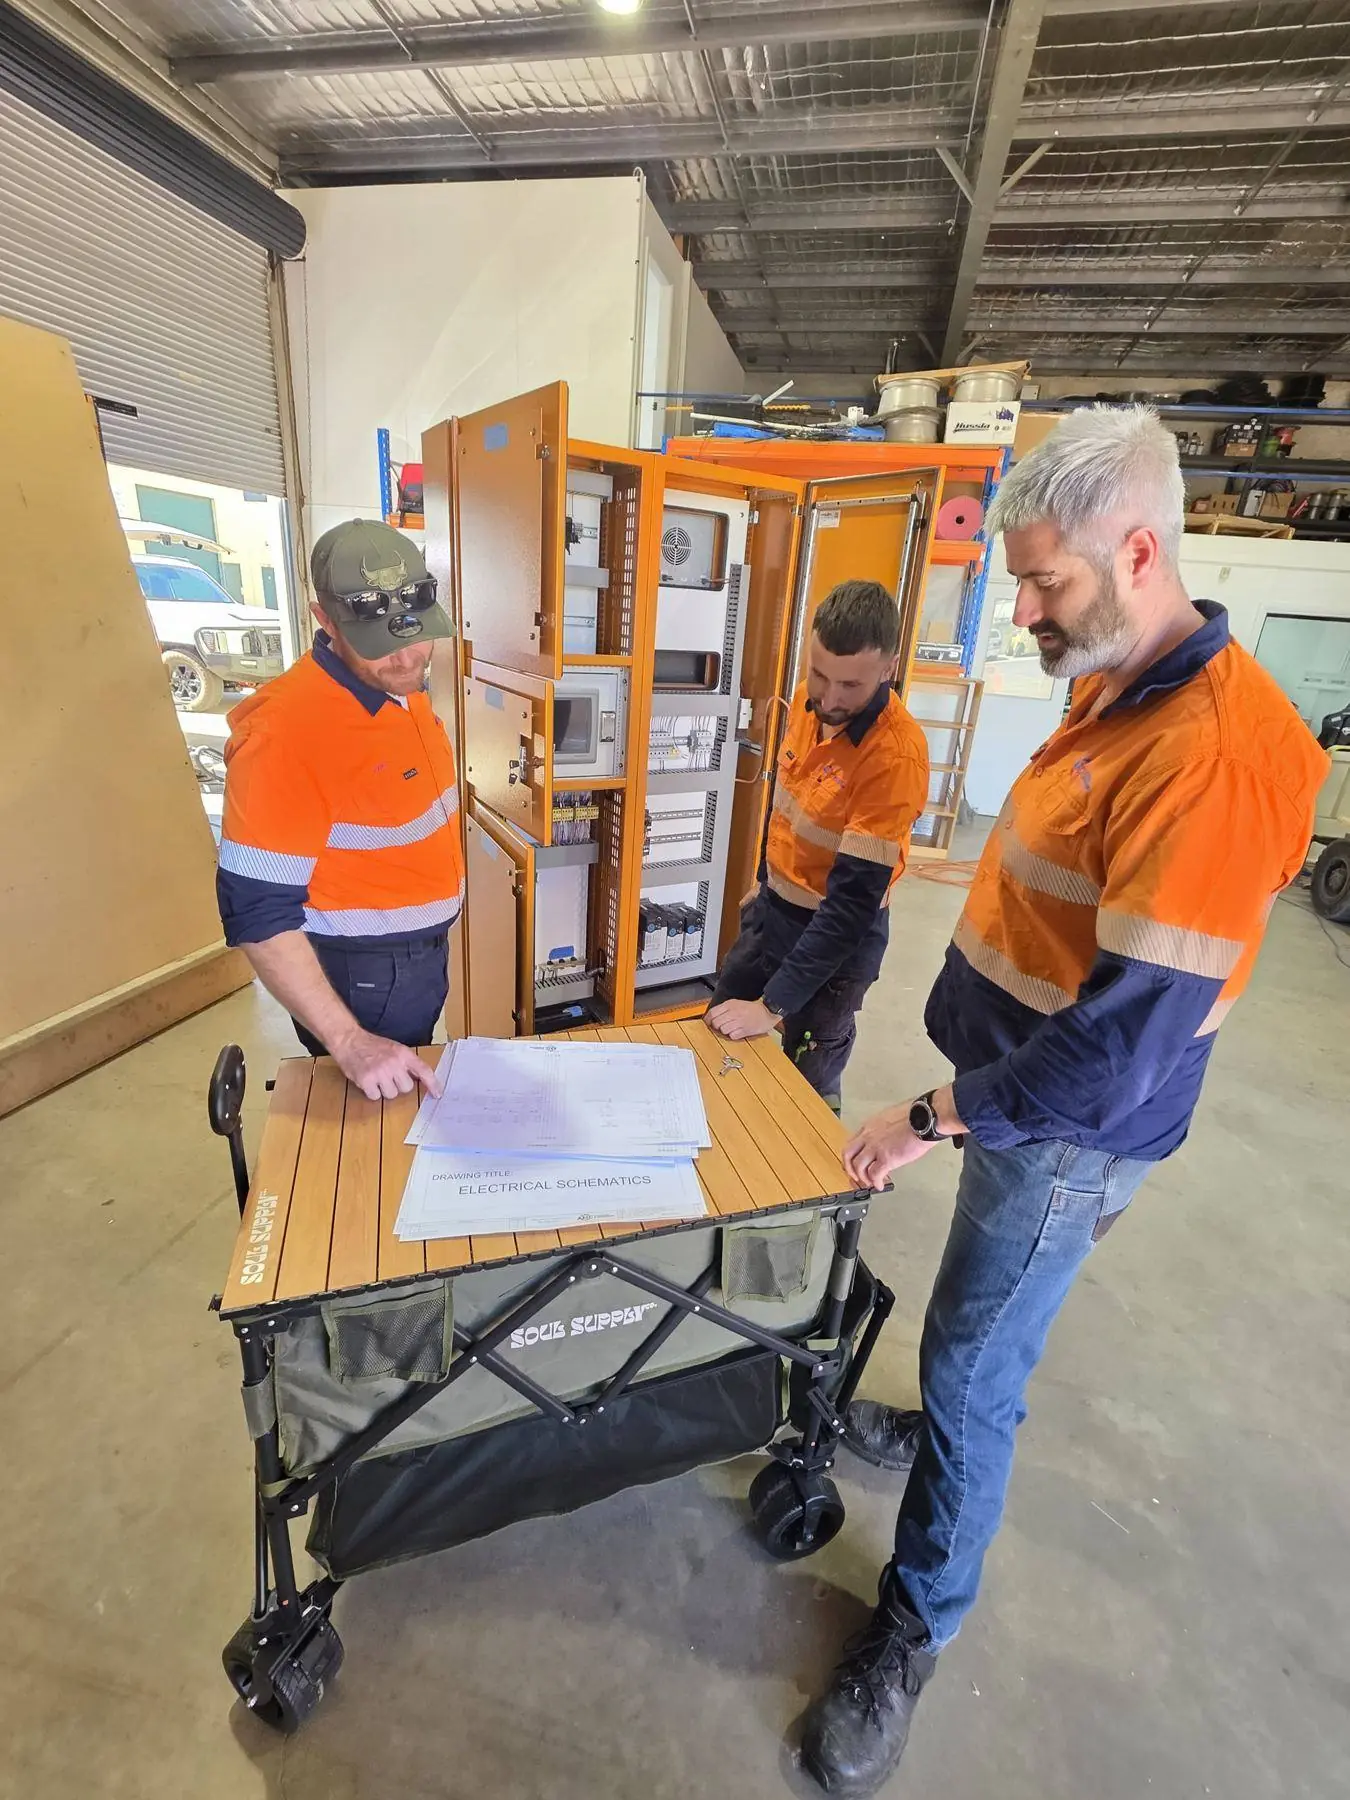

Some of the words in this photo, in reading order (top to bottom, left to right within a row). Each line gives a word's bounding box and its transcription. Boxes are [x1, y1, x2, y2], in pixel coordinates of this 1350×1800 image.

[432, 1172, 481, 1181] DRAWING
[458, 1181, 551, 1195] ELECTRICAL
[556, 1175, 652, 1189] SCHEMATICS
[250, 1195, 279, 1243] SUPPLY
[240, 1244, 268, 1285] SOUL
[510, 1320, 566, 1349] SOUL
[570, 1304, 645, 1336] SUPPLY
